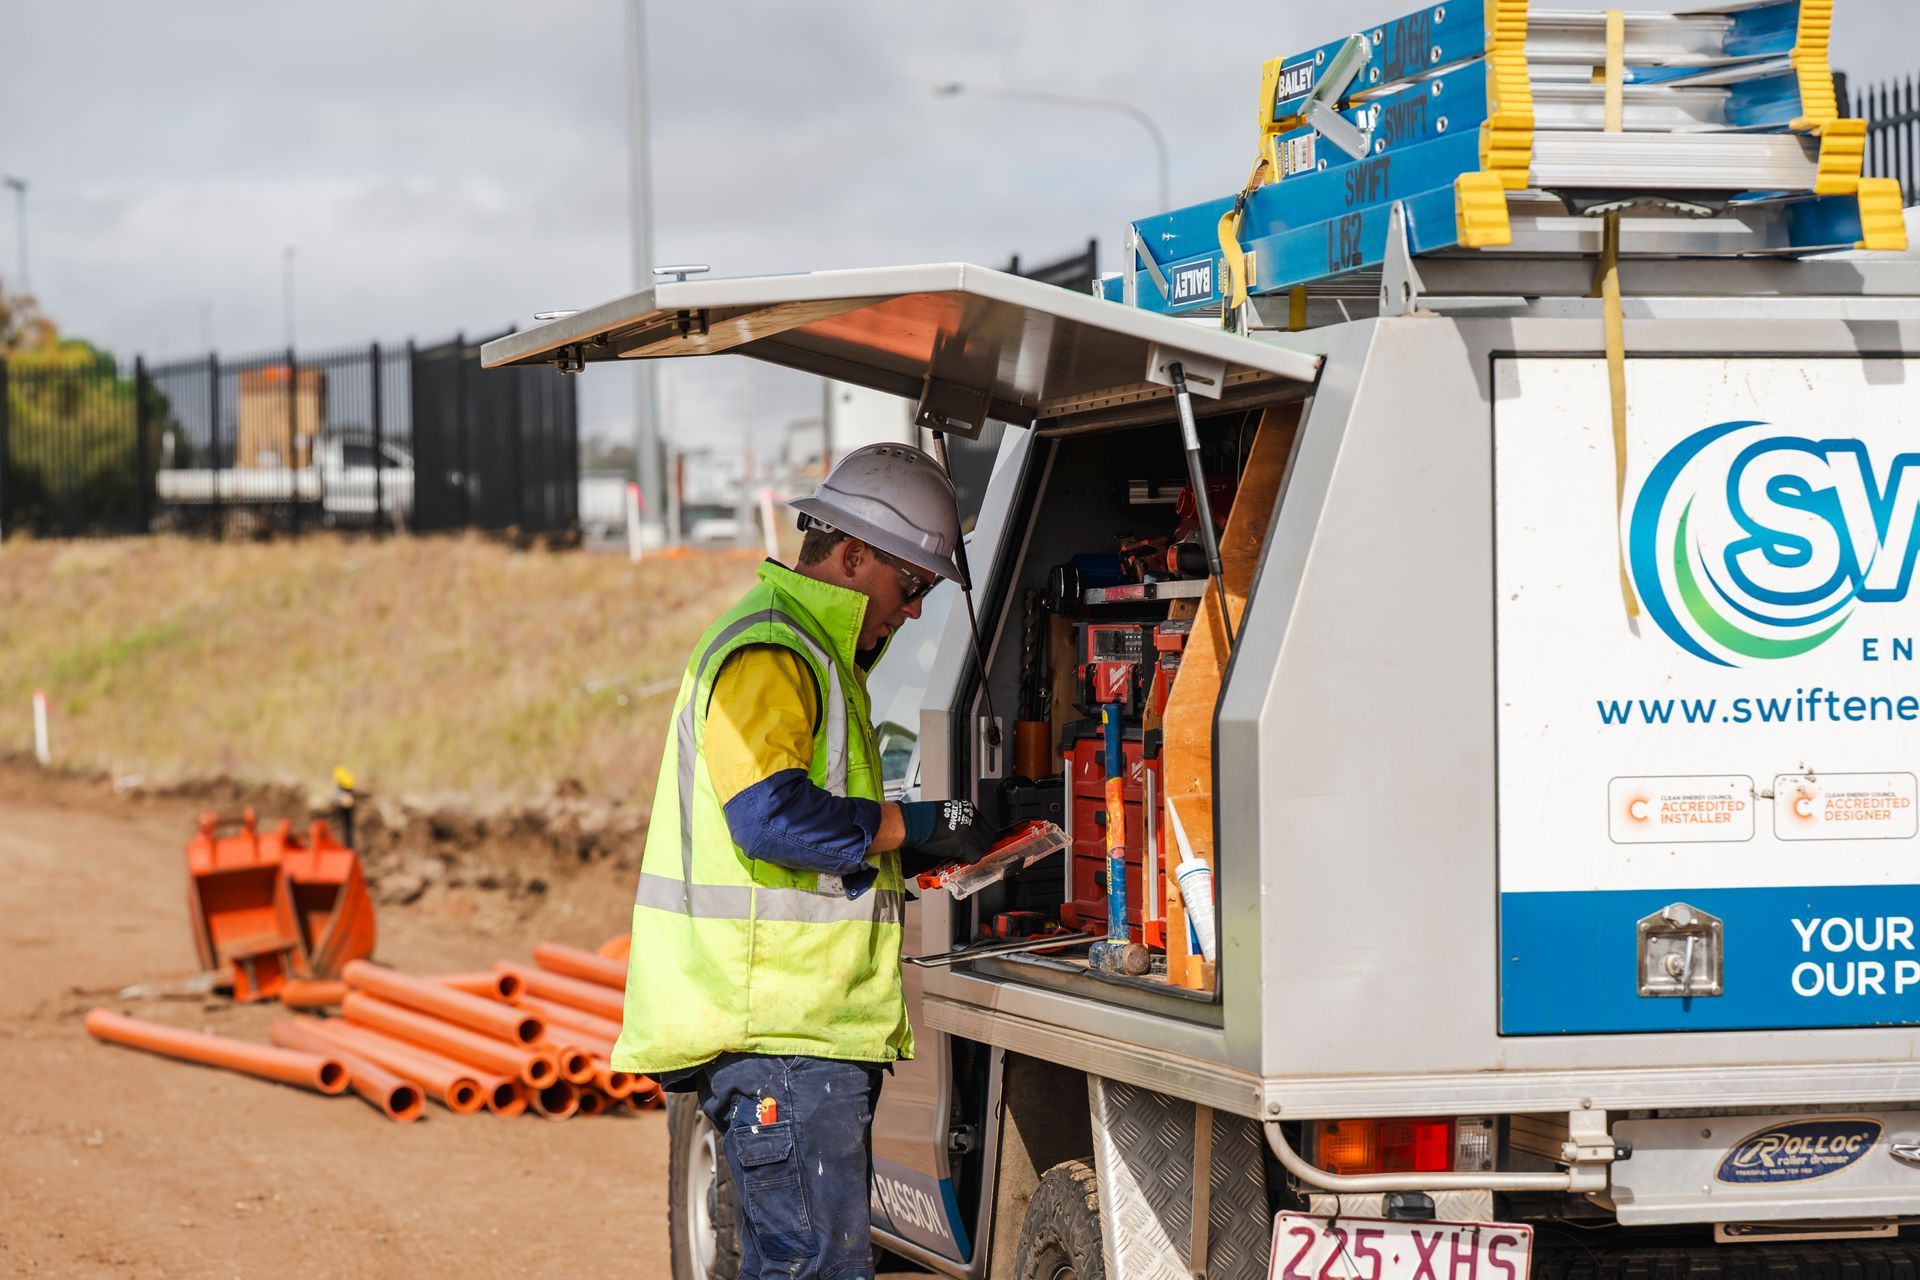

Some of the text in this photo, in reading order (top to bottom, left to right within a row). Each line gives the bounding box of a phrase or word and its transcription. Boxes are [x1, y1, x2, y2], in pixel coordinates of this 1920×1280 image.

[1278, 65, 1313, 98] BAILEY
[1384, 95, 1428, 146] SWIFT
[1344, 156, 1391, 207] SWIFT
[1174, 266, 1211, 299] BAILEY
[1661, 801, 1745, 812] ACCREDITED
[1661, 812, 1732, 824] INSTALLER
[1825, 797, 1910, 809] ACCREDITED
[1825, 810, 1891, 821] DESIGNER
[1791, 916, 1916, 952] YOUR
[1791, 961, 1887, 997] OUR
[1777, 1154, 1808, 1166] roller
[876, 1173, 949, 1239] PASSION.
